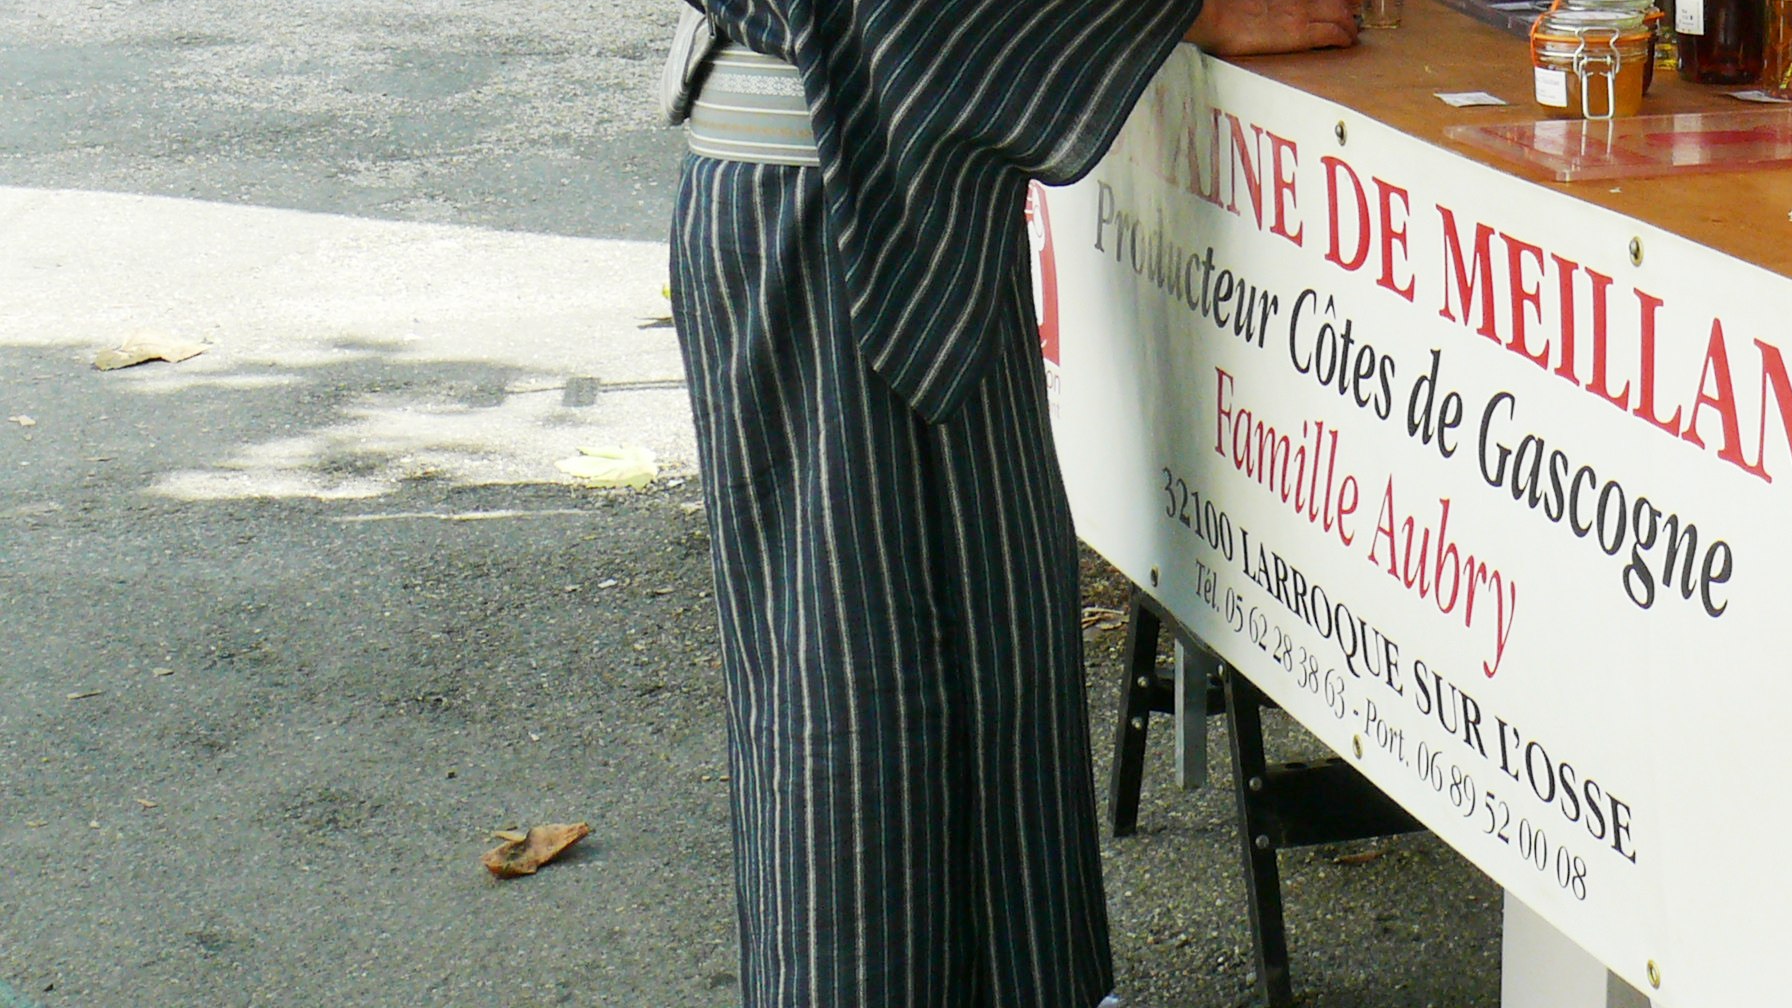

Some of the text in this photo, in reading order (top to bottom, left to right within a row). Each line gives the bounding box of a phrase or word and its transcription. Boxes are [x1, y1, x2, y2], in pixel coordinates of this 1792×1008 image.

[1094, 179, 1734, 618] Producteur Côtes de Gascogne
[1320, 155, 1415, 303] DE
[1163, 466, 1637, 865] 32100 LARROQUE SUR L'OSSE
[1214, 366, 1517, 679] Famille Aubry
[1195, 558, 1220, 613] Tél.
[1225, 586, 1244, 633] 05
[1249, 606, 1268, 652] 62
[1272, 625, 1294, 673] 28
[1297, 646, 1320, 694] 38
[1324, 668, 1346, 720] 63
[1364, 697, 1409, 768] Port.
[1417, 740, 1444, 792] 06
[1449, 764, 1476, 818] 89
[1483, 791, 1510, 845] 52
[1519, 817, 1548, 871] 00
[1556, 845, 1587, 901] 08
